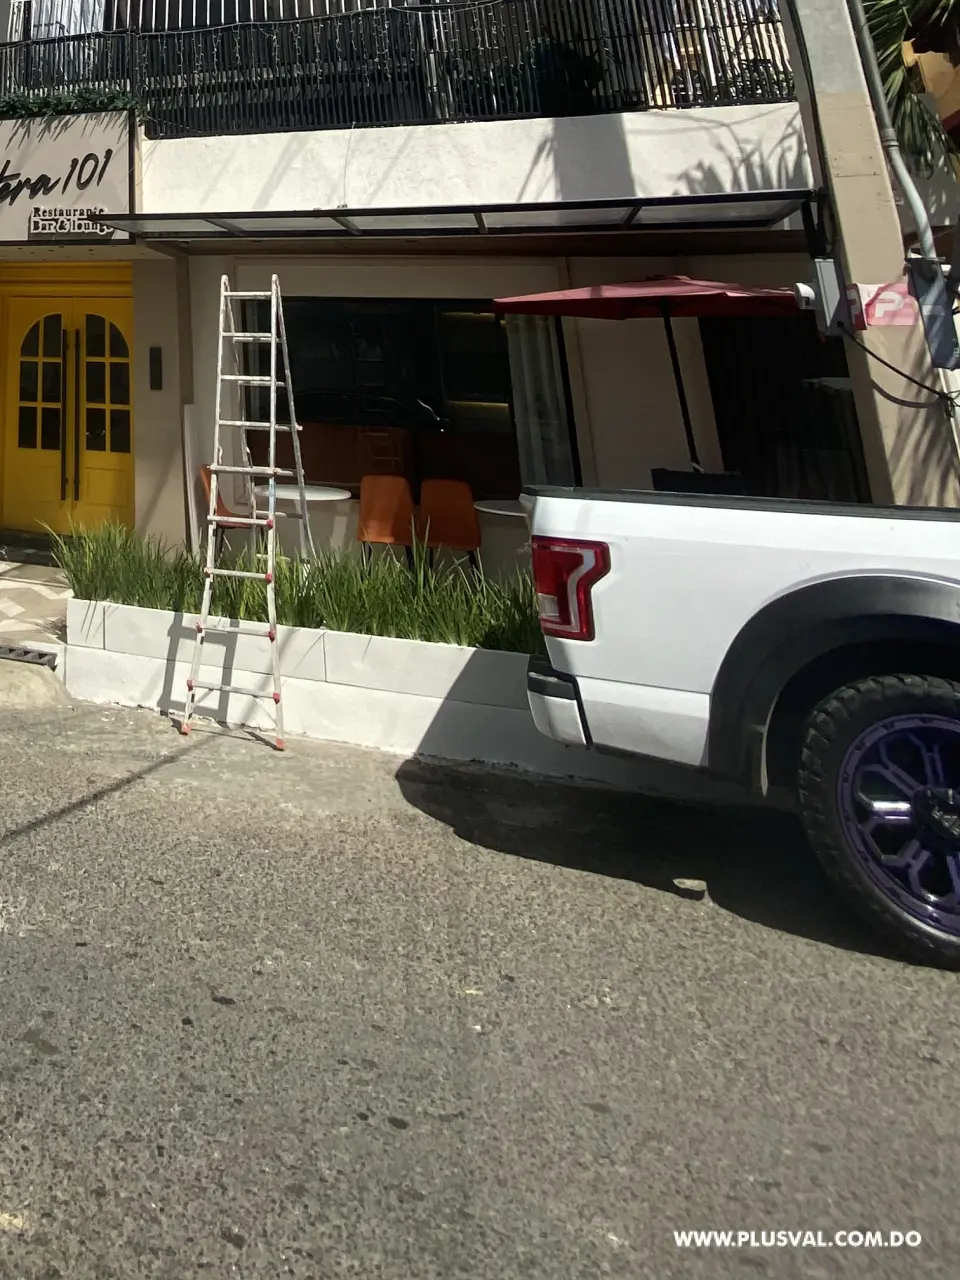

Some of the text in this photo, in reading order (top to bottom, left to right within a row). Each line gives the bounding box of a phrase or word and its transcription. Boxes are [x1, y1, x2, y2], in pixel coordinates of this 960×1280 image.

[61, 148, 114, 195] 101
[32, 220, 54, 231] Bar
[58, 219, 68, 231] &
